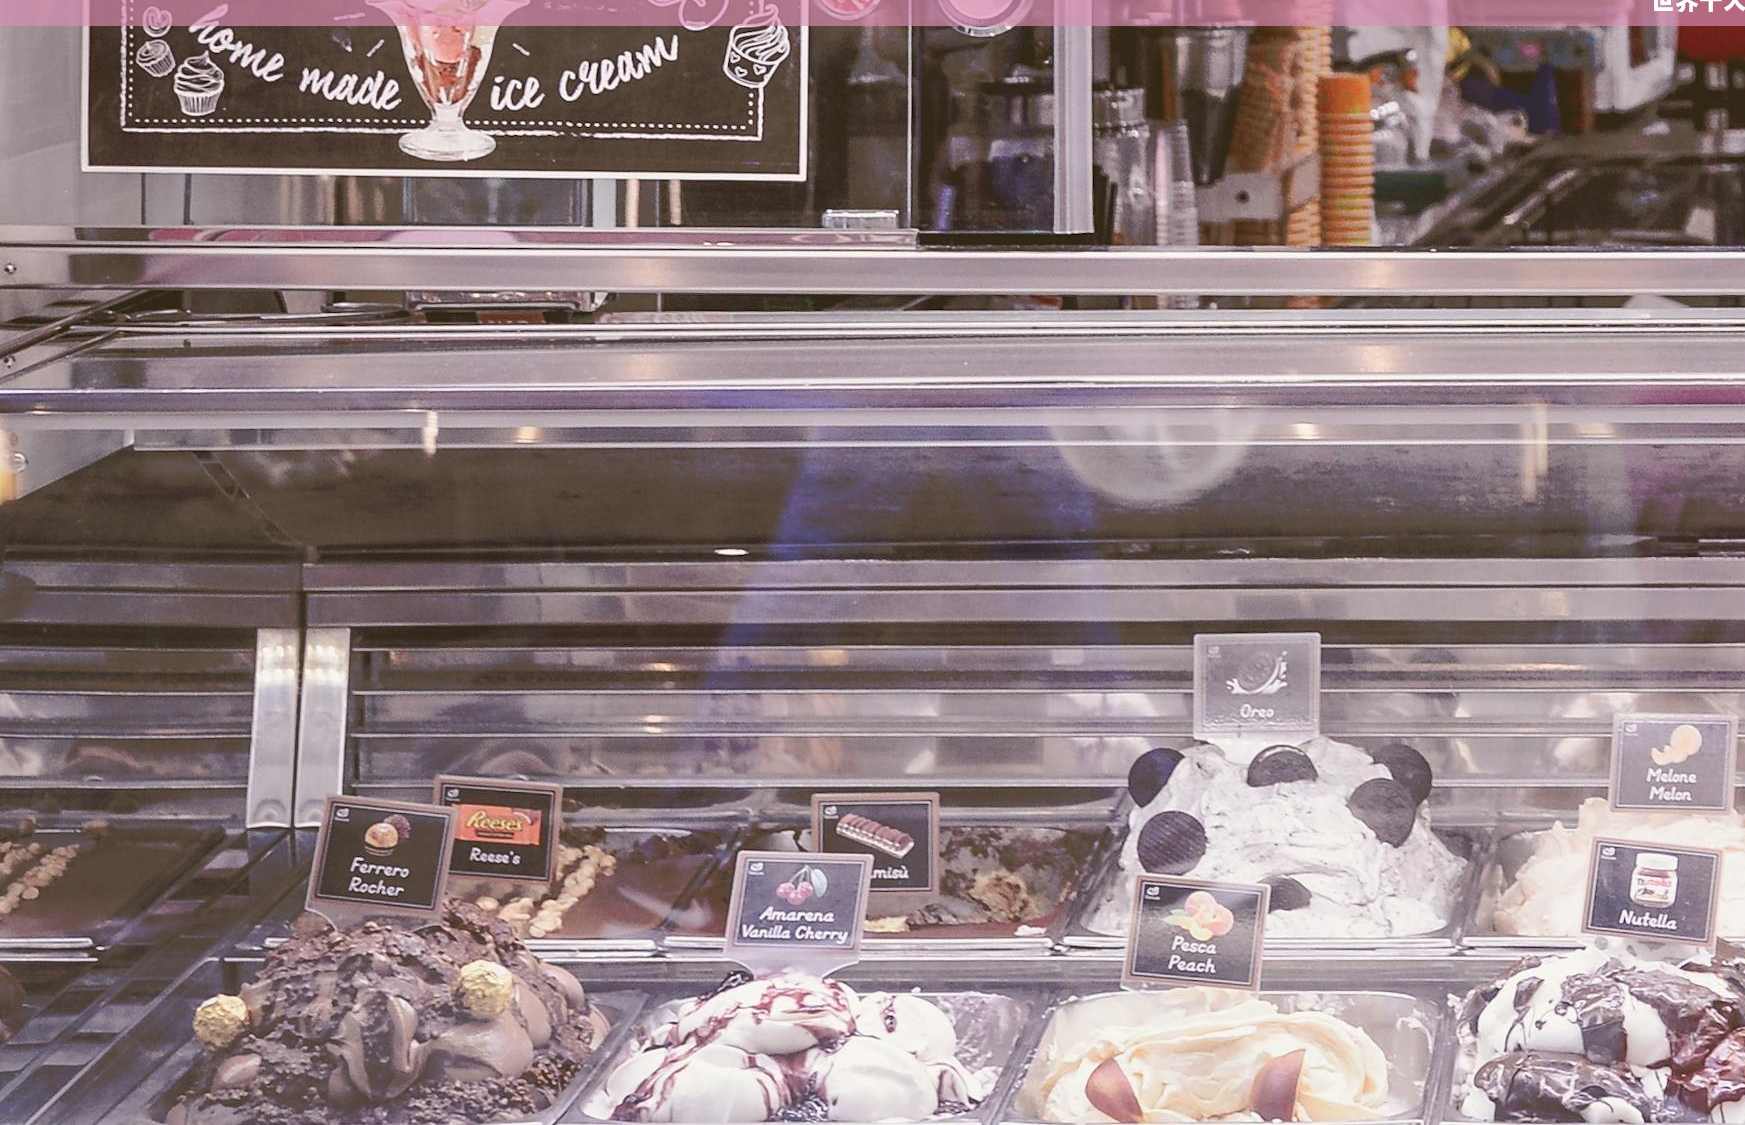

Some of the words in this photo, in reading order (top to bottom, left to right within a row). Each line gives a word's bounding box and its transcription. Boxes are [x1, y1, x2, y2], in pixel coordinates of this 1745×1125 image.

[188, 3, 285, 83] home
[299, 63, 402, 111] made
[490, 73, 545, 112] ice
[558, 34, 680, 103] cream
[1239, 703, 1275, 719] Oreo
[1646, 768, 1698, 784] Melone
[1648, 786, 1693, 802] Melon
[469, 847, 521, 866] Reese's
[350, 857, 410, 878] Ferrero
[870, 864, 909, 880] misù
[348, 876, 405, 898] Rocher
[759, 906, 835, 923] Amarena
[1618, 909, 1678, 930] Nutella
[740, 924, 791, 941] Vanilla
[794, 924, 849, 944] Cherry
[1171, 935, 1217, 955] Pesca
[1167, 954, 1217, 974] Peach
